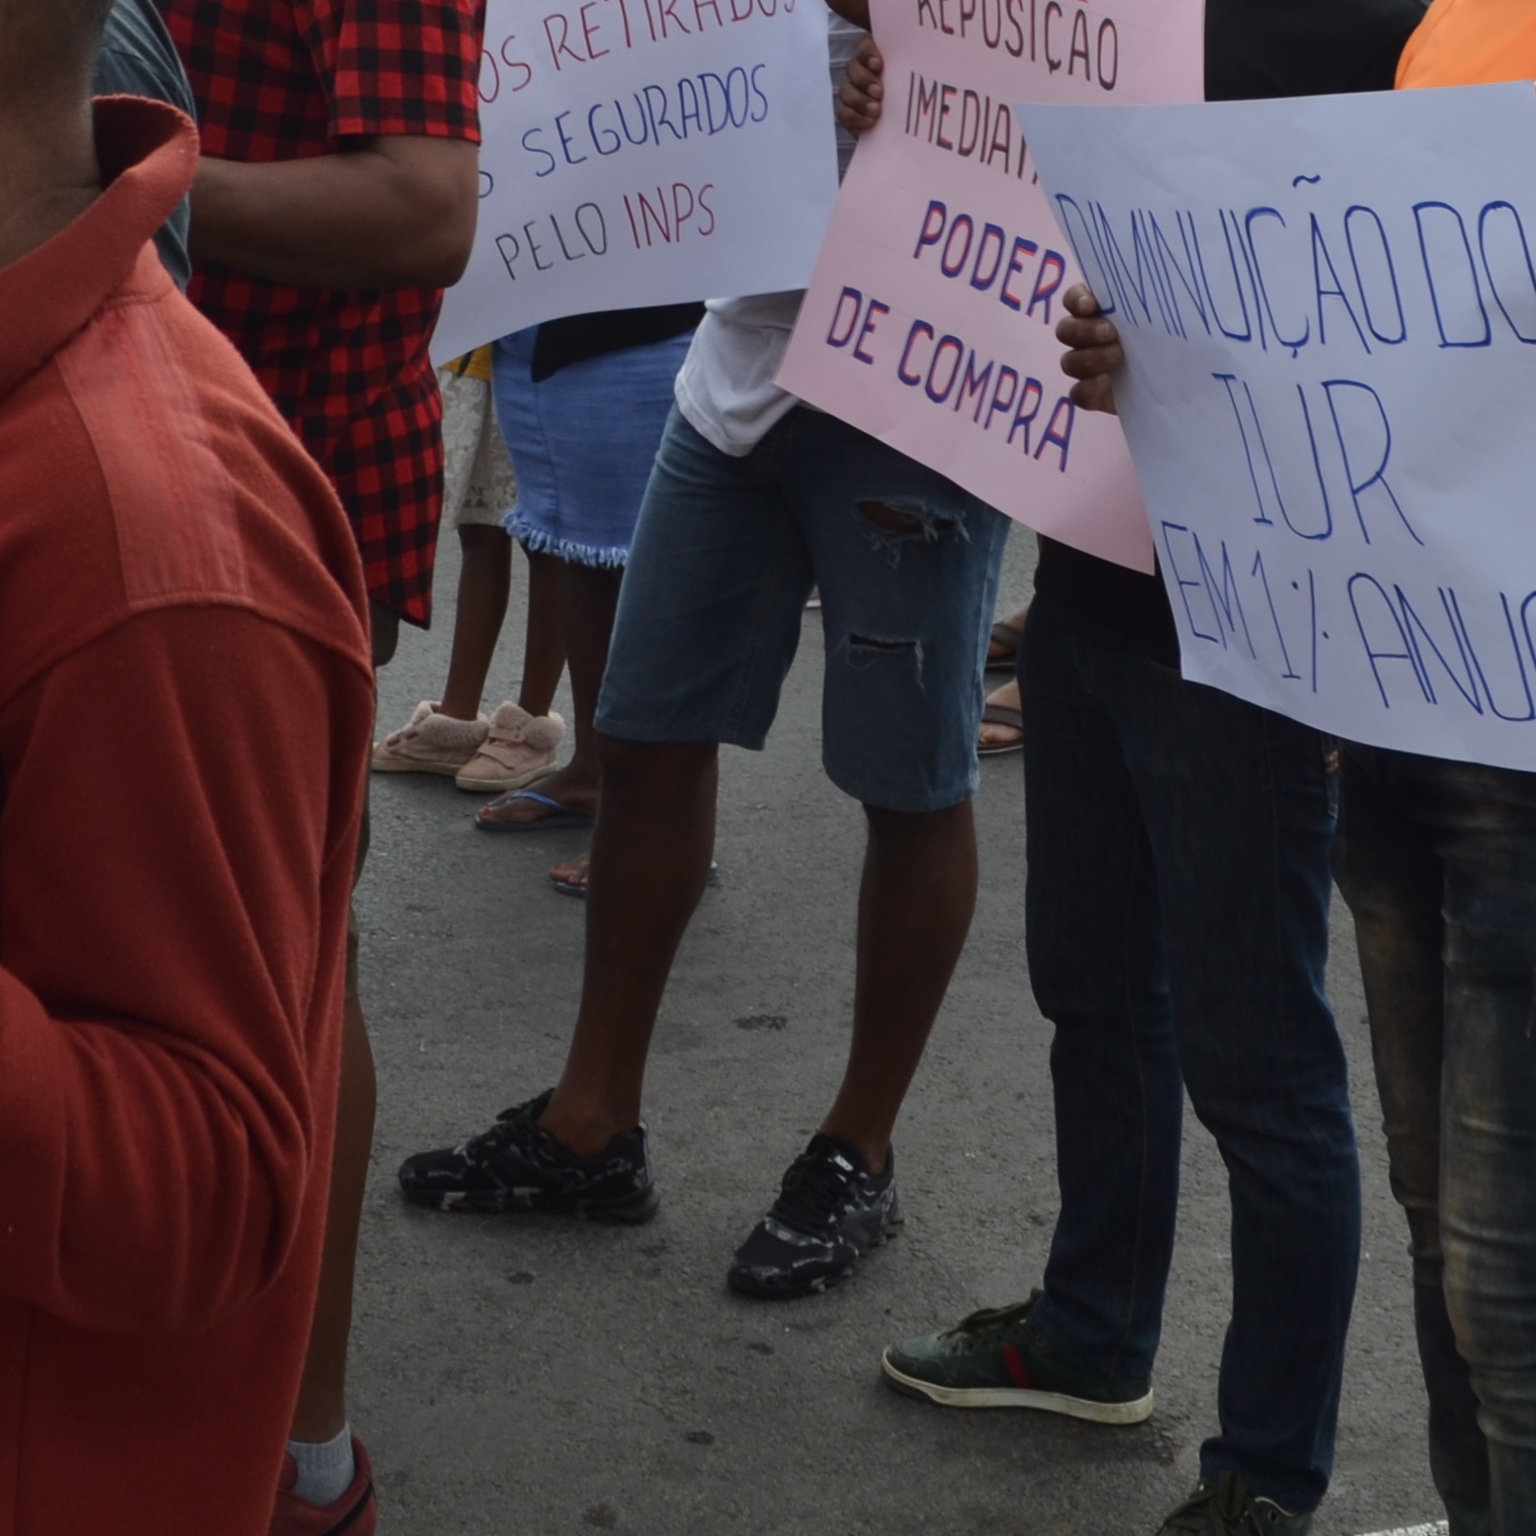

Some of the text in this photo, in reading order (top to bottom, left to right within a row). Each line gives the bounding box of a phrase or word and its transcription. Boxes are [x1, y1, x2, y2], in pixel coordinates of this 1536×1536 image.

[521, 64, 769, 177] SEGURADOS
[495, 182, 715, 281] PELO INPS
[913, 199, 1067, 325] PODER
[826, 286, 1076, 474] DE COMPRA
[1161, 520, 1257, 661] EM
